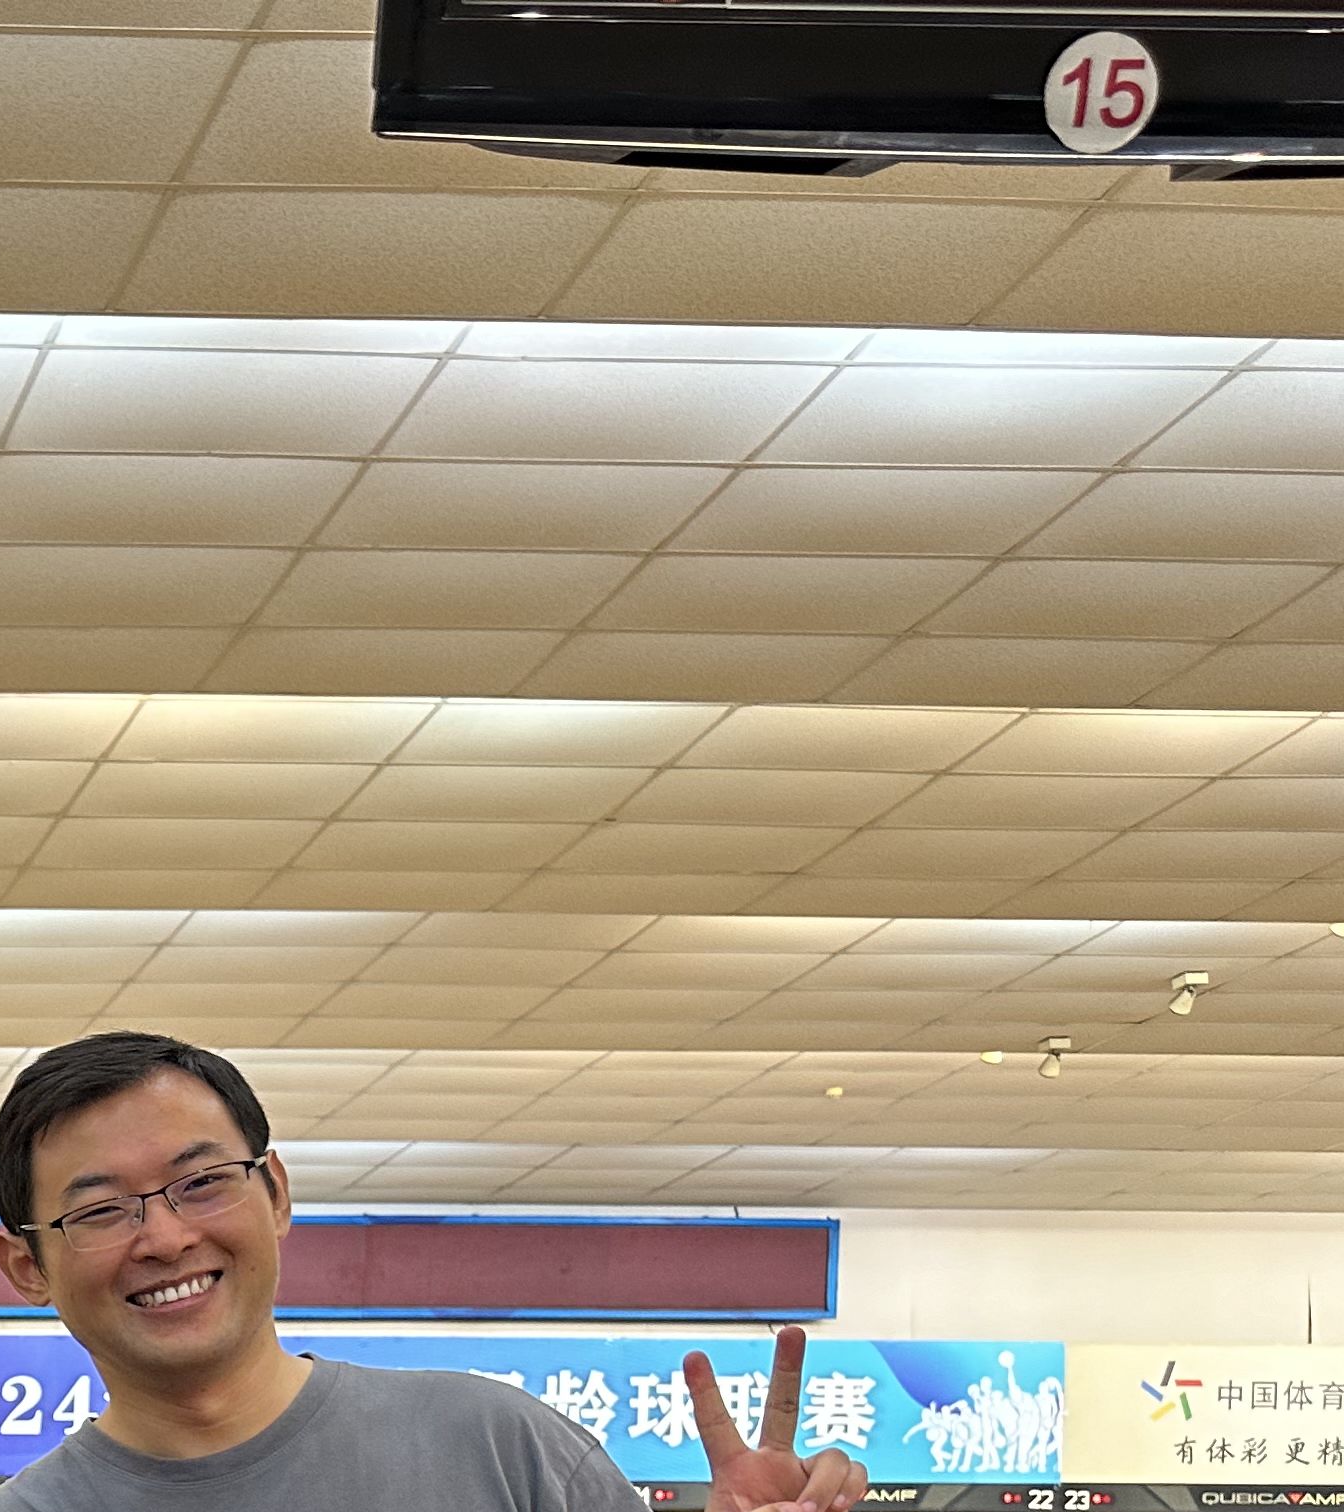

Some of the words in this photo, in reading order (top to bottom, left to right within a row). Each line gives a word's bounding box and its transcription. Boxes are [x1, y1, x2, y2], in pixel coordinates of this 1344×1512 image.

[1063, 58, 1146, 129] 15
[467, 1369, 878, 1450] 龄球联赛
[1218, 1379, 1344, 1411] 中国体育
[1174, 1435, 1268, 1465] 有体彩
[1028, 1489, 1054, 1510] 22
[1064, 1490, 1091, 1511] 23
